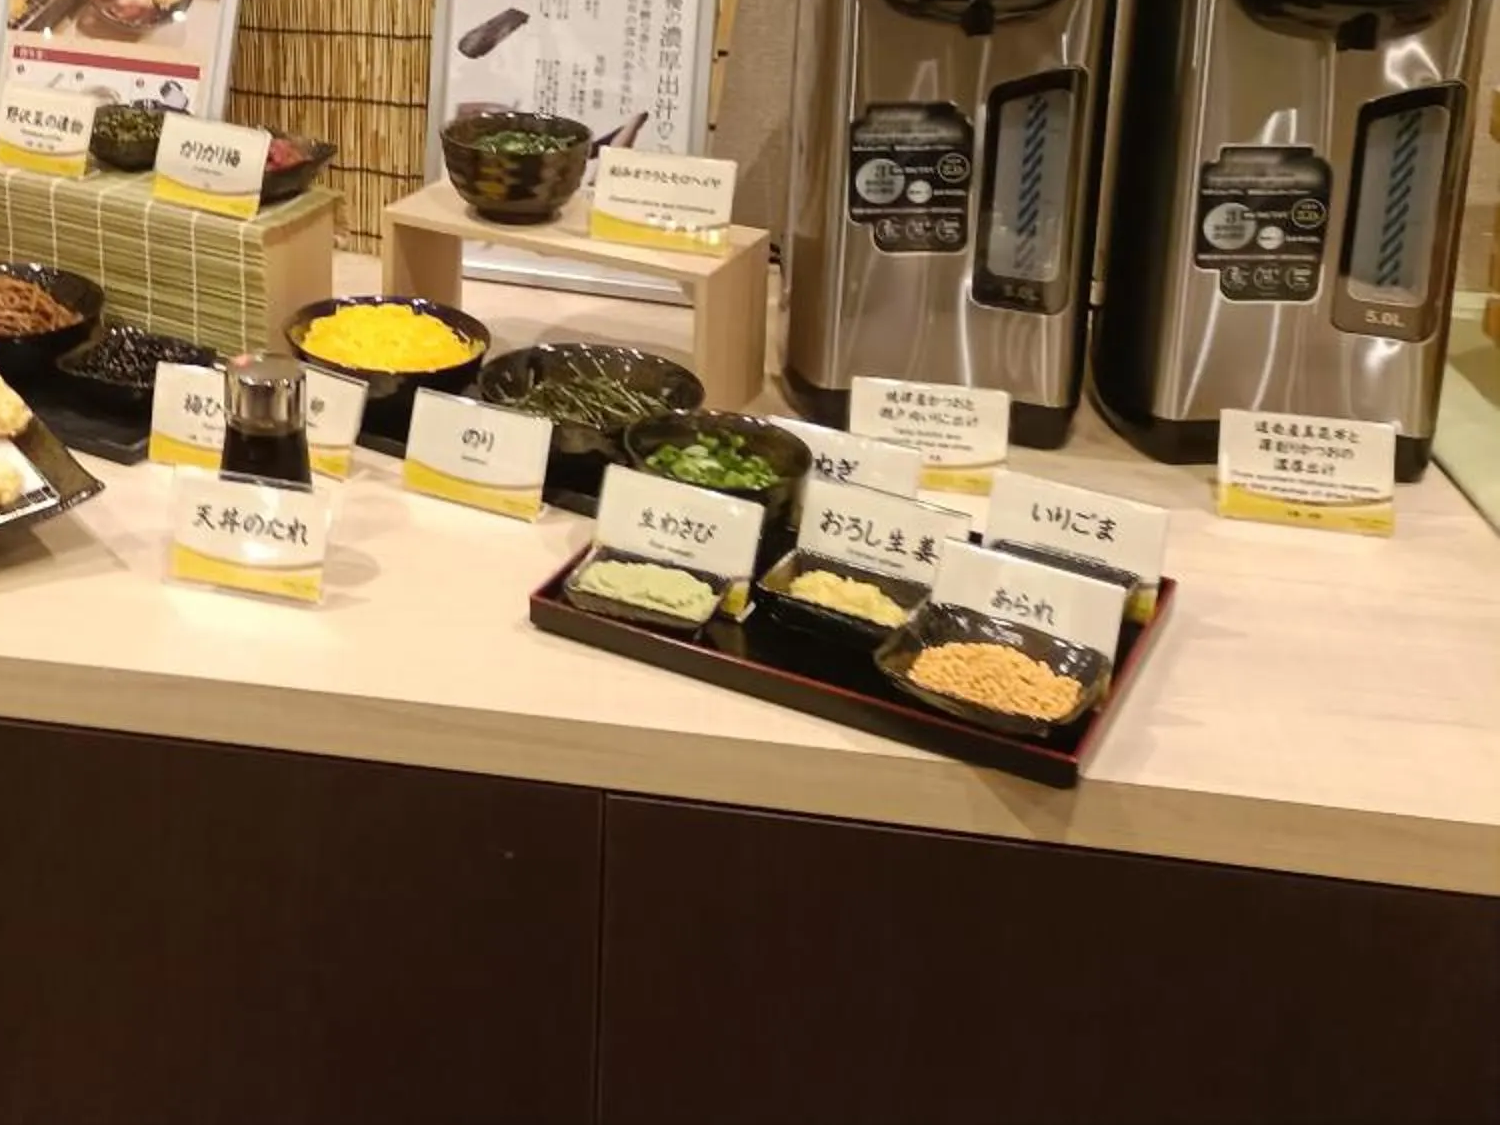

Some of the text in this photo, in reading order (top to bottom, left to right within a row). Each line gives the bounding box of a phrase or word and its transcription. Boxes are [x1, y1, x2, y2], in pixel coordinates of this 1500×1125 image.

[461, 428, 495, 452] のり
[815, 453, 860, 481] ねぎ
[192, 503, 309, 547] 天丼のたれ
[638, 506, 718, 545] 生わさび
[820, 508, 940, 565] おろし生姜
[1031, 503, 1117, 543] いりごま
[991, 587, 1055, 626] あられ
